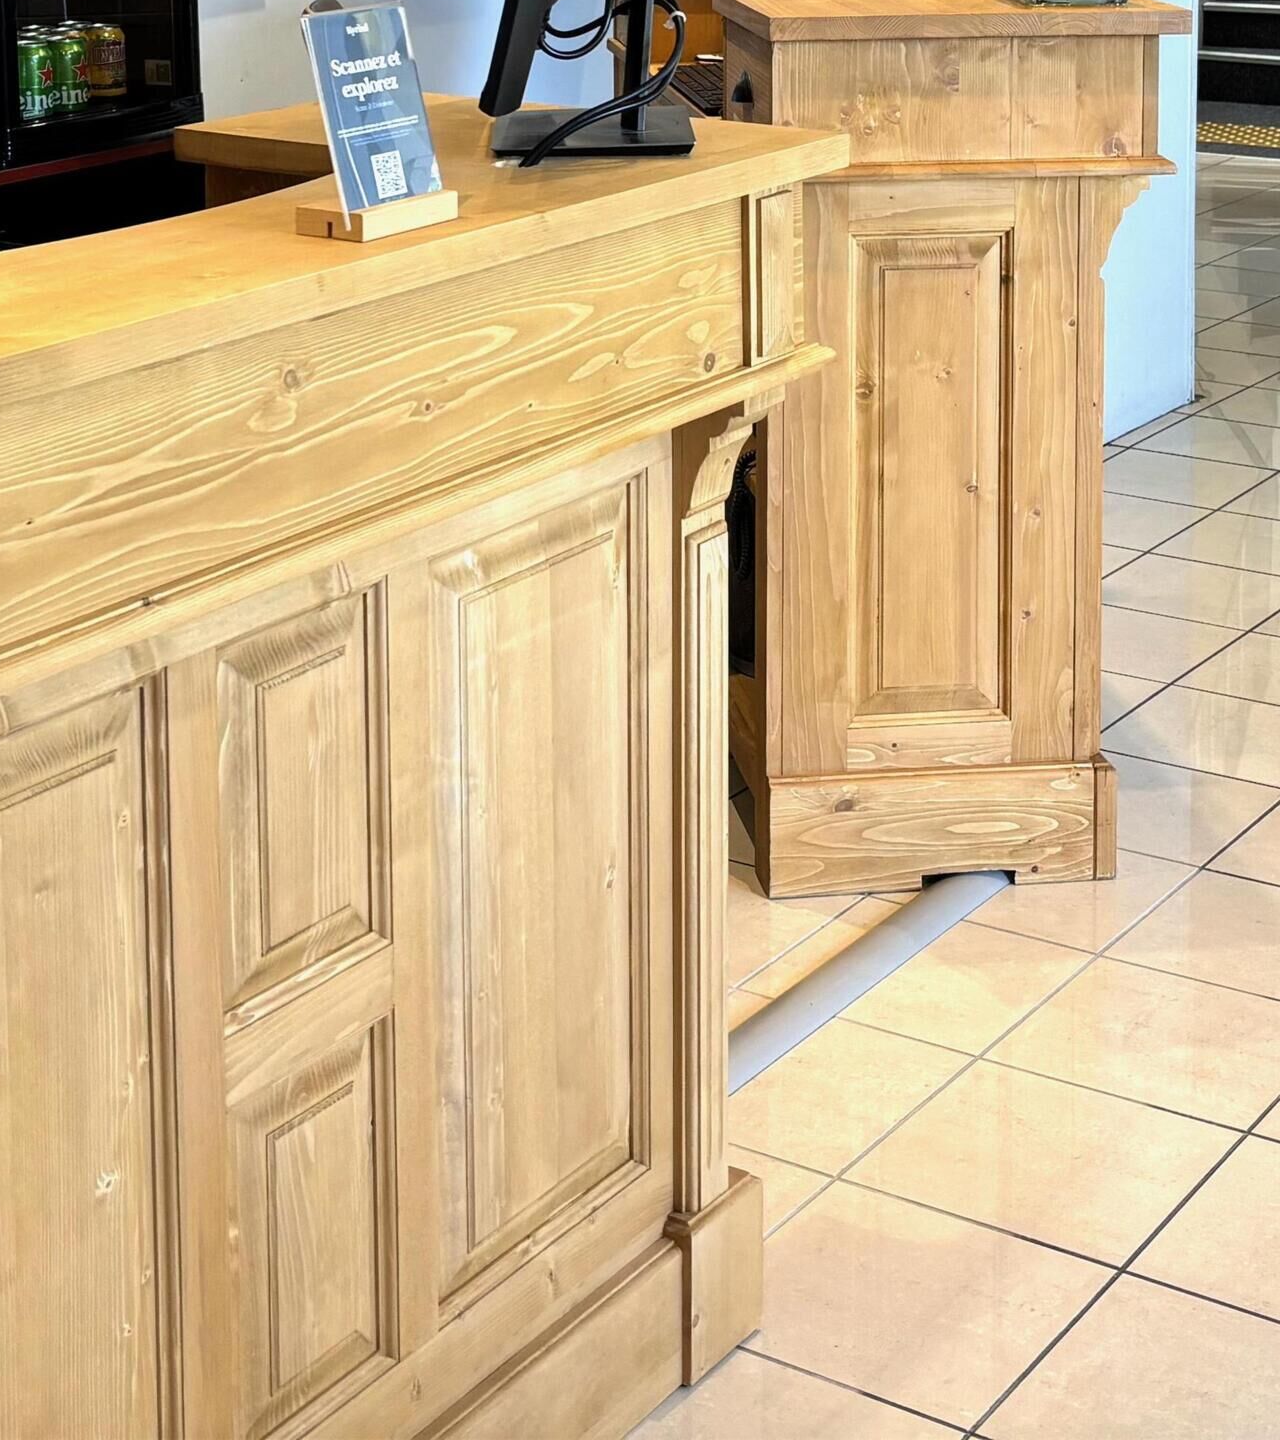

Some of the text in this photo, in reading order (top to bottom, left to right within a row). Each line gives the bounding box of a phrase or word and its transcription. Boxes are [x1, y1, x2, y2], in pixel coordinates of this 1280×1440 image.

[331, 50, 402, 77] Scannez et
[342, 76, 399, 101] explorez
